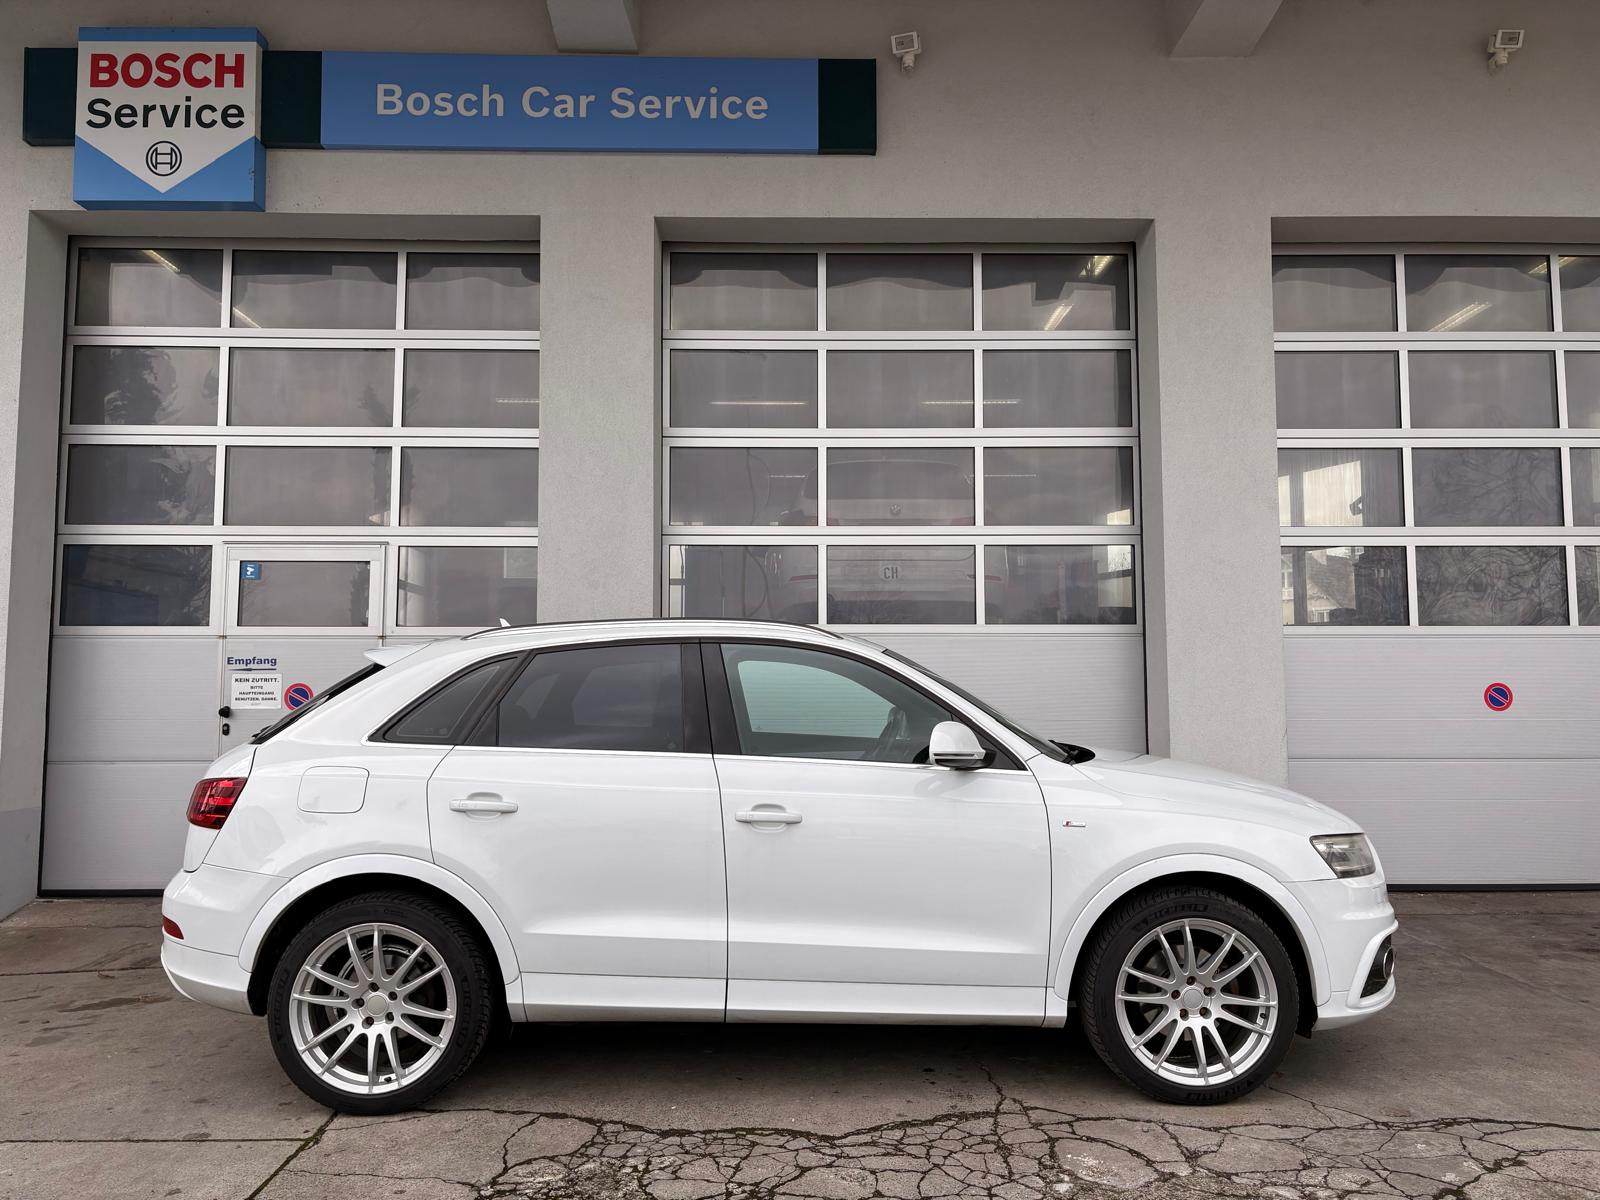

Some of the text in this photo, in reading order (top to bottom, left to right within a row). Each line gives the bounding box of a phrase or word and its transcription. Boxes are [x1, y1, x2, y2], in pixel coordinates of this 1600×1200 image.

[90, 53, 245, 89] BOSCH
[85, 96, 246, 130] Service
[376, 83, 769, 122] Bosch Car Service
[883, 566, 898, 580] CH
[226, 656, 277, 667] Empfang
